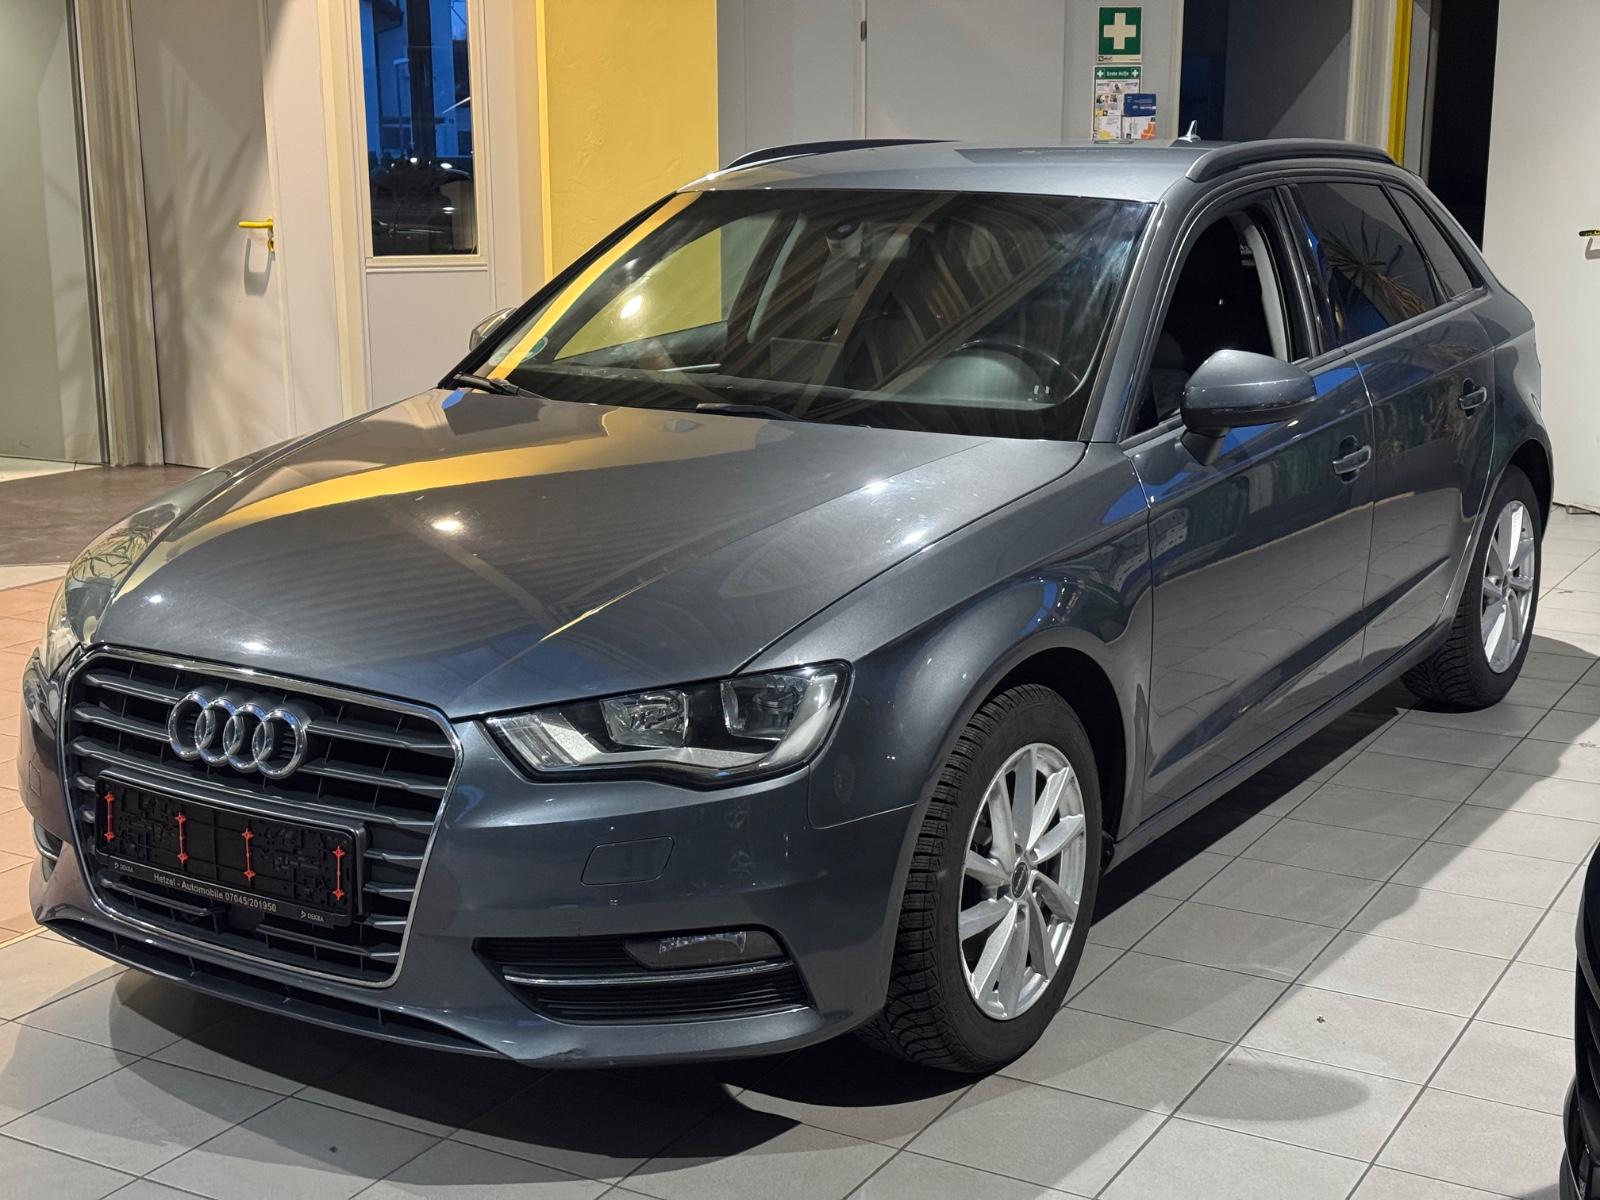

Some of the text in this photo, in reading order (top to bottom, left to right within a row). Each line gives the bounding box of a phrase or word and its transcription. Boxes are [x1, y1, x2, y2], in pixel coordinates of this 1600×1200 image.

[153, 873, 176, 886] Hetzel
[181, 881, 223, 899] Automobile
[224, 893, 277, 912] 07045/201950
[307, 913, 325, 922] DEKRA
